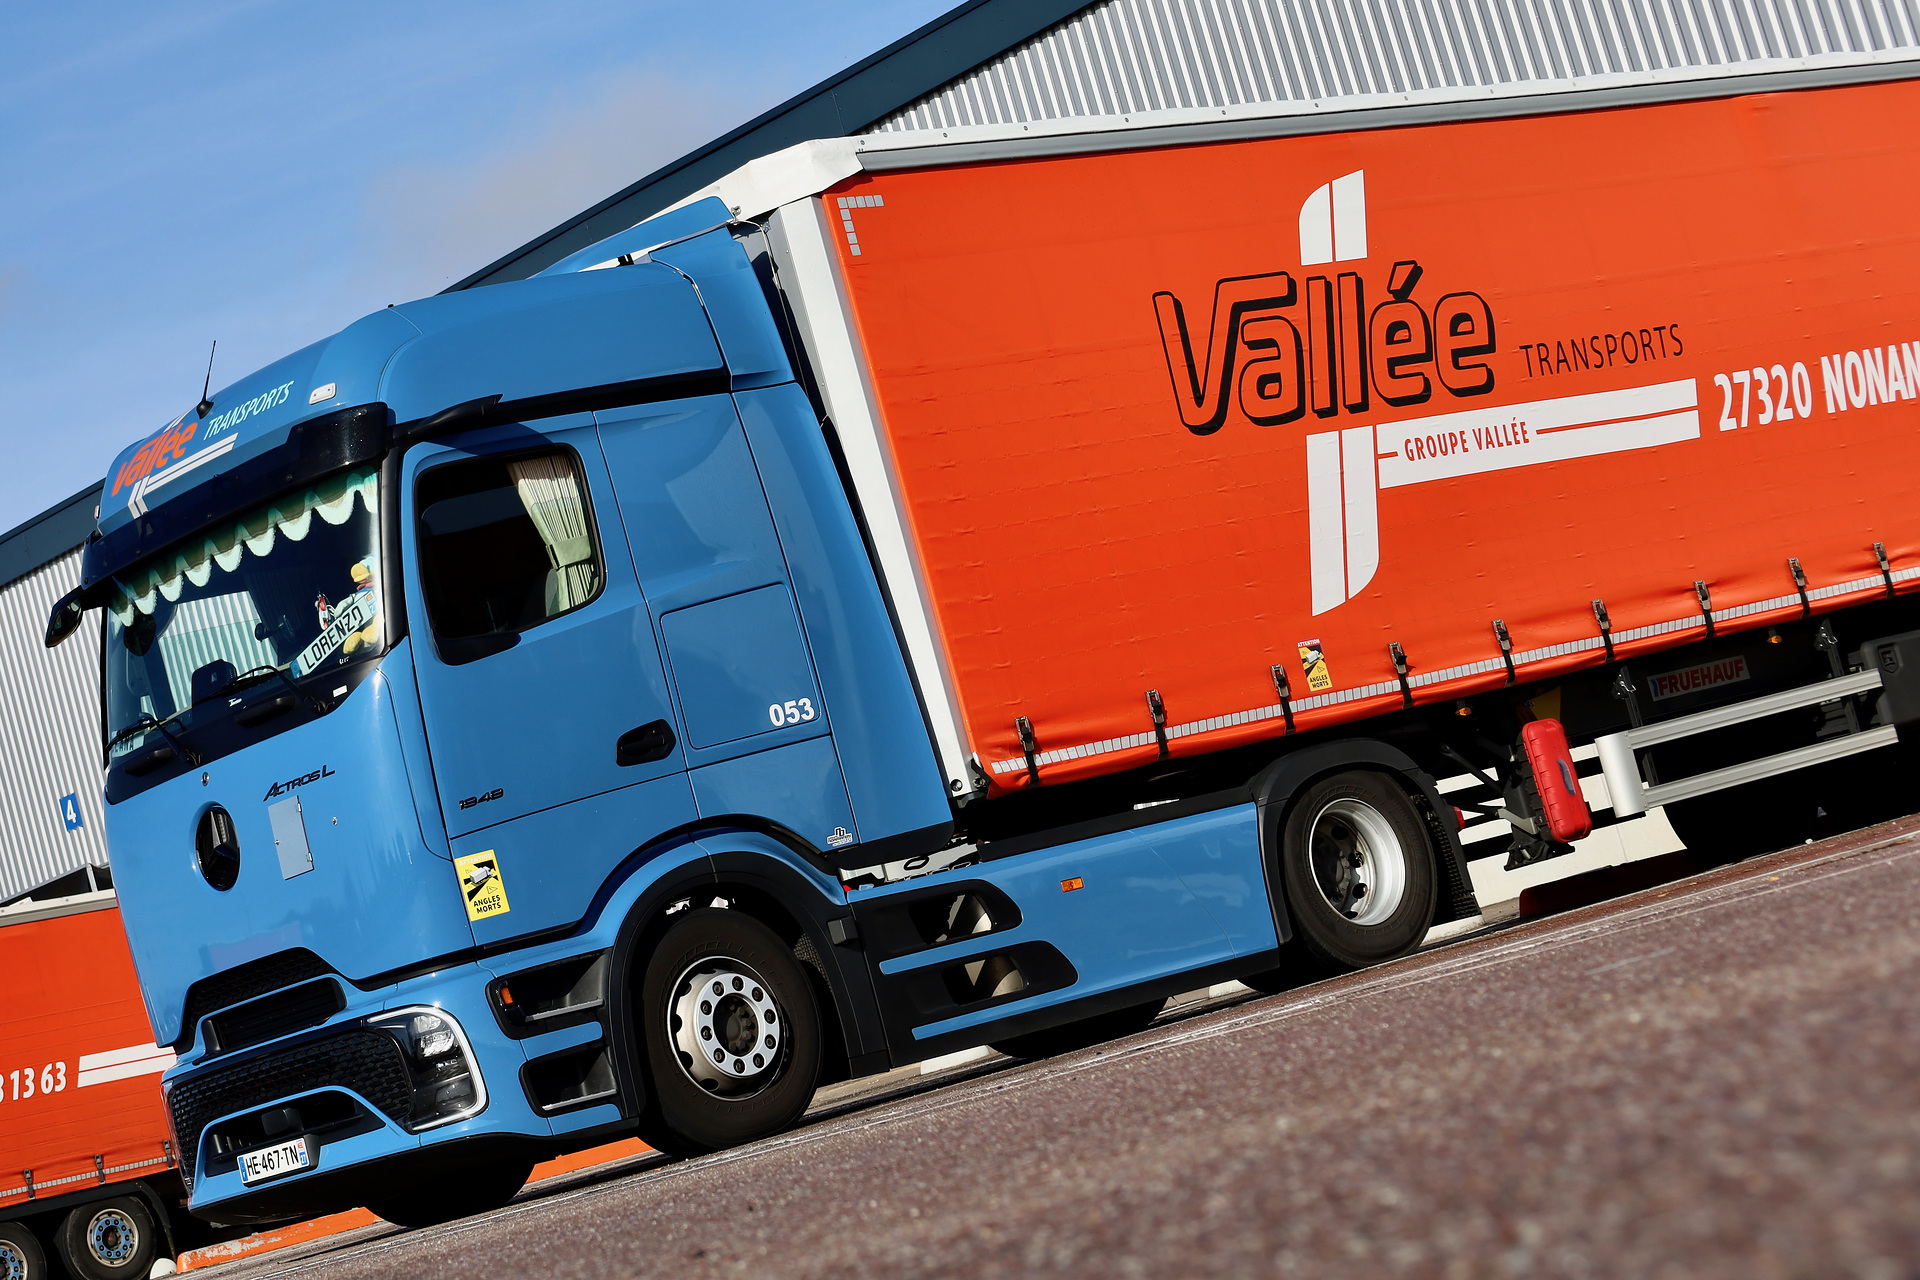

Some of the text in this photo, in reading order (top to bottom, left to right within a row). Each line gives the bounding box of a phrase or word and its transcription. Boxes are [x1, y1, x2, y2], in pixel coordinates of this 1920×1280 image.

[1152, 260, 1684, 436] Vallée TRANSPORTS
[1713, 361, 1812, 432] 27320
[110, 380, 295, 498] Vallée TRANSPORTS
[1404, 416, 1530, 462] GROUPE VALLÉE
[302, 605, 364, 670] LORENZO
[1297, 638, 1321, 648] ATTENTION
[1309, 674, 1328, 683] ANGLES
[1312, 680, 1329, 689] MORTS
[1655, 658, 1745, 697] FRUEHAUF
[768, 697, 815, 727] 053
[321, 764, 336, 778] L
[66, 799, 77, 824] 4
[458, 787, 504, 811] 1948
[458, 852, 494, 867] ATTENTION
[473, 894, 501, 908] ANGLES
[476, 902, 502, 914] MORTS
[10, 1067, 35, 1101] 13
[40, 1061, 67, 1095] 63
[245, 1144, 300, 1177] HE-467-TN
